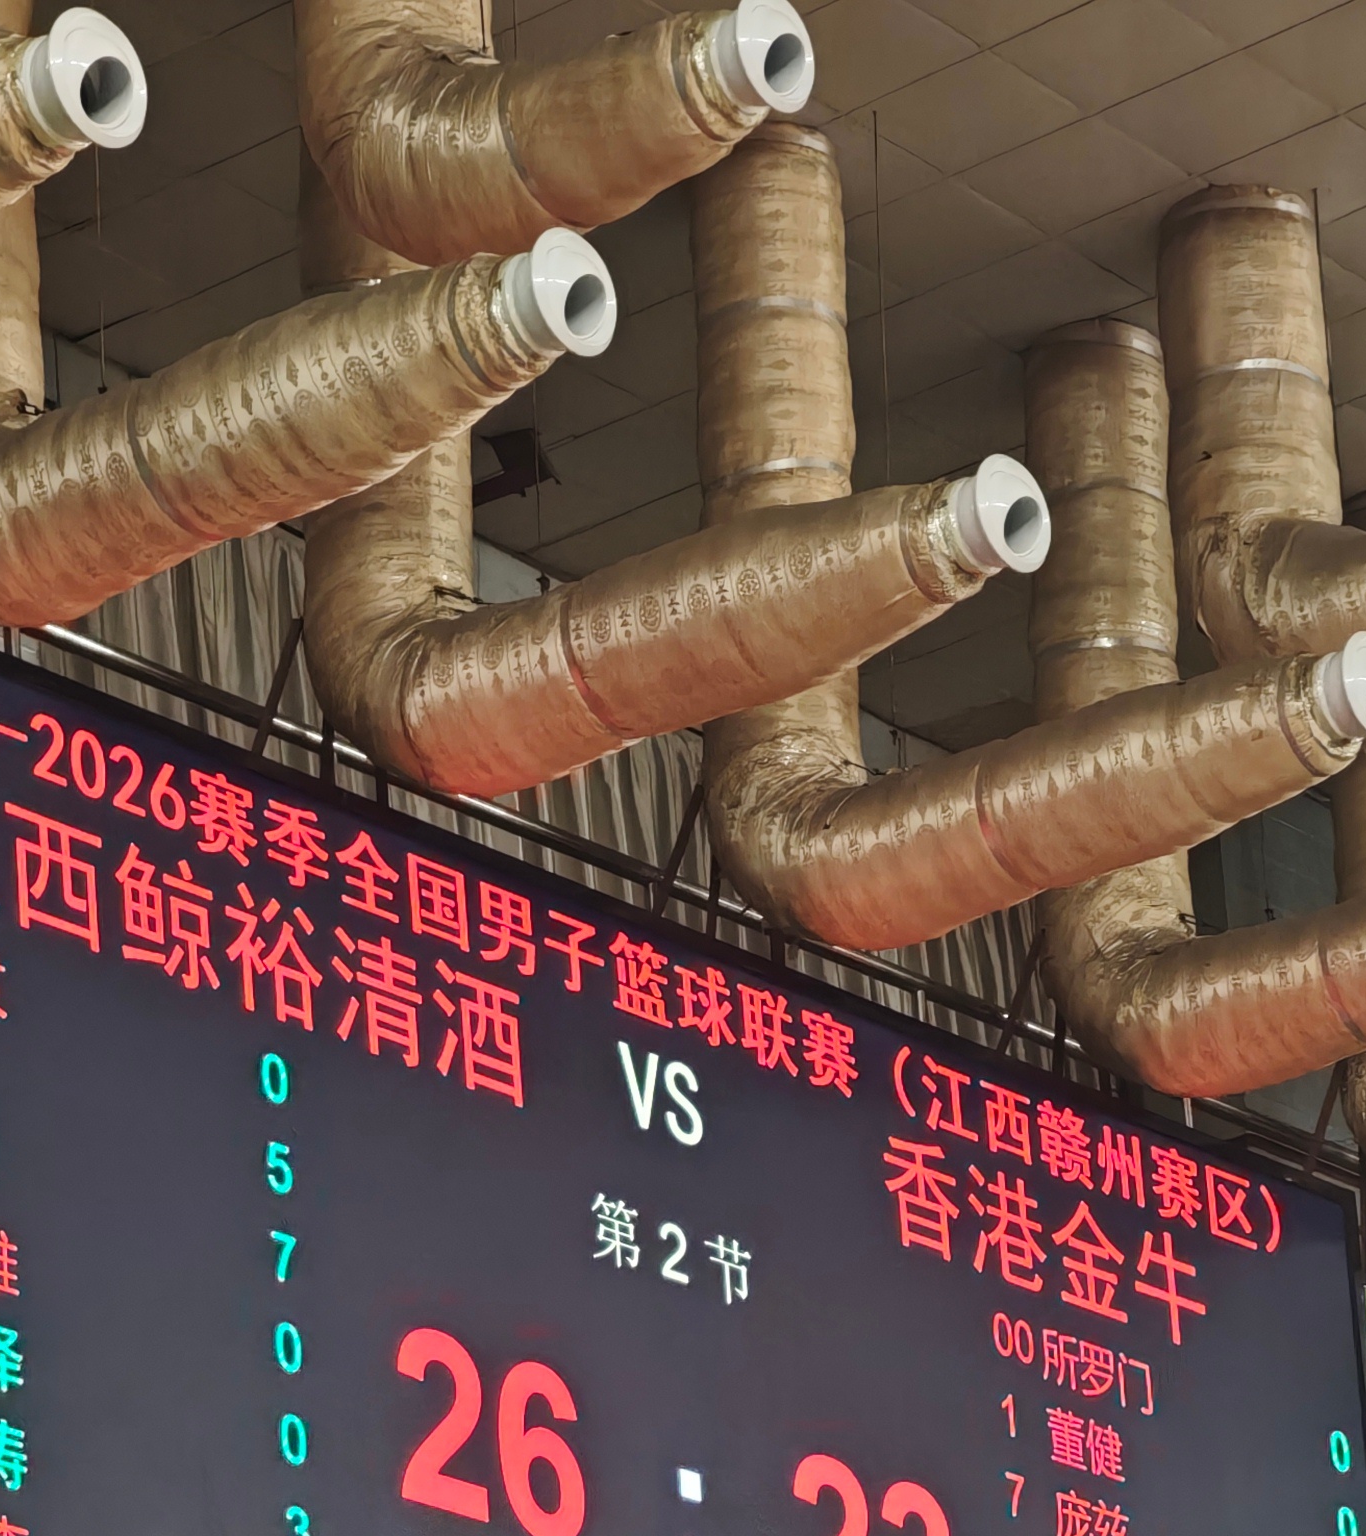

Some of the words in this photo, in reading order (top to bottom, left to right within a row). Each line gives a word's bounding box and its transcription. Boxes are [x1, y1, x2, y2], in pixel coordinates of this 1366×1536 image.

[262, 1053, 291, 1106] 0
[618, 1041, 704, 1146] VS
[267, 1142, 293, 1196] 5
[270, 1231, 298, 1282] 7
[884, 1137, 1207, 1345] 香港金牛
[274, 1321, 302, 1374] 0
[992, 1312, 1035, 1365] 00
[1042, 1327, 1155, 1416] 所罗门
[1329, 1430, 1352, 1473] 0
[279, 1414, 310, 1468] 0
[1001, 1393, 1016, 1438] 1
[1046, 1407, 1127, 1483] 董健
[1004, 1472, 1025, 1517] 7
